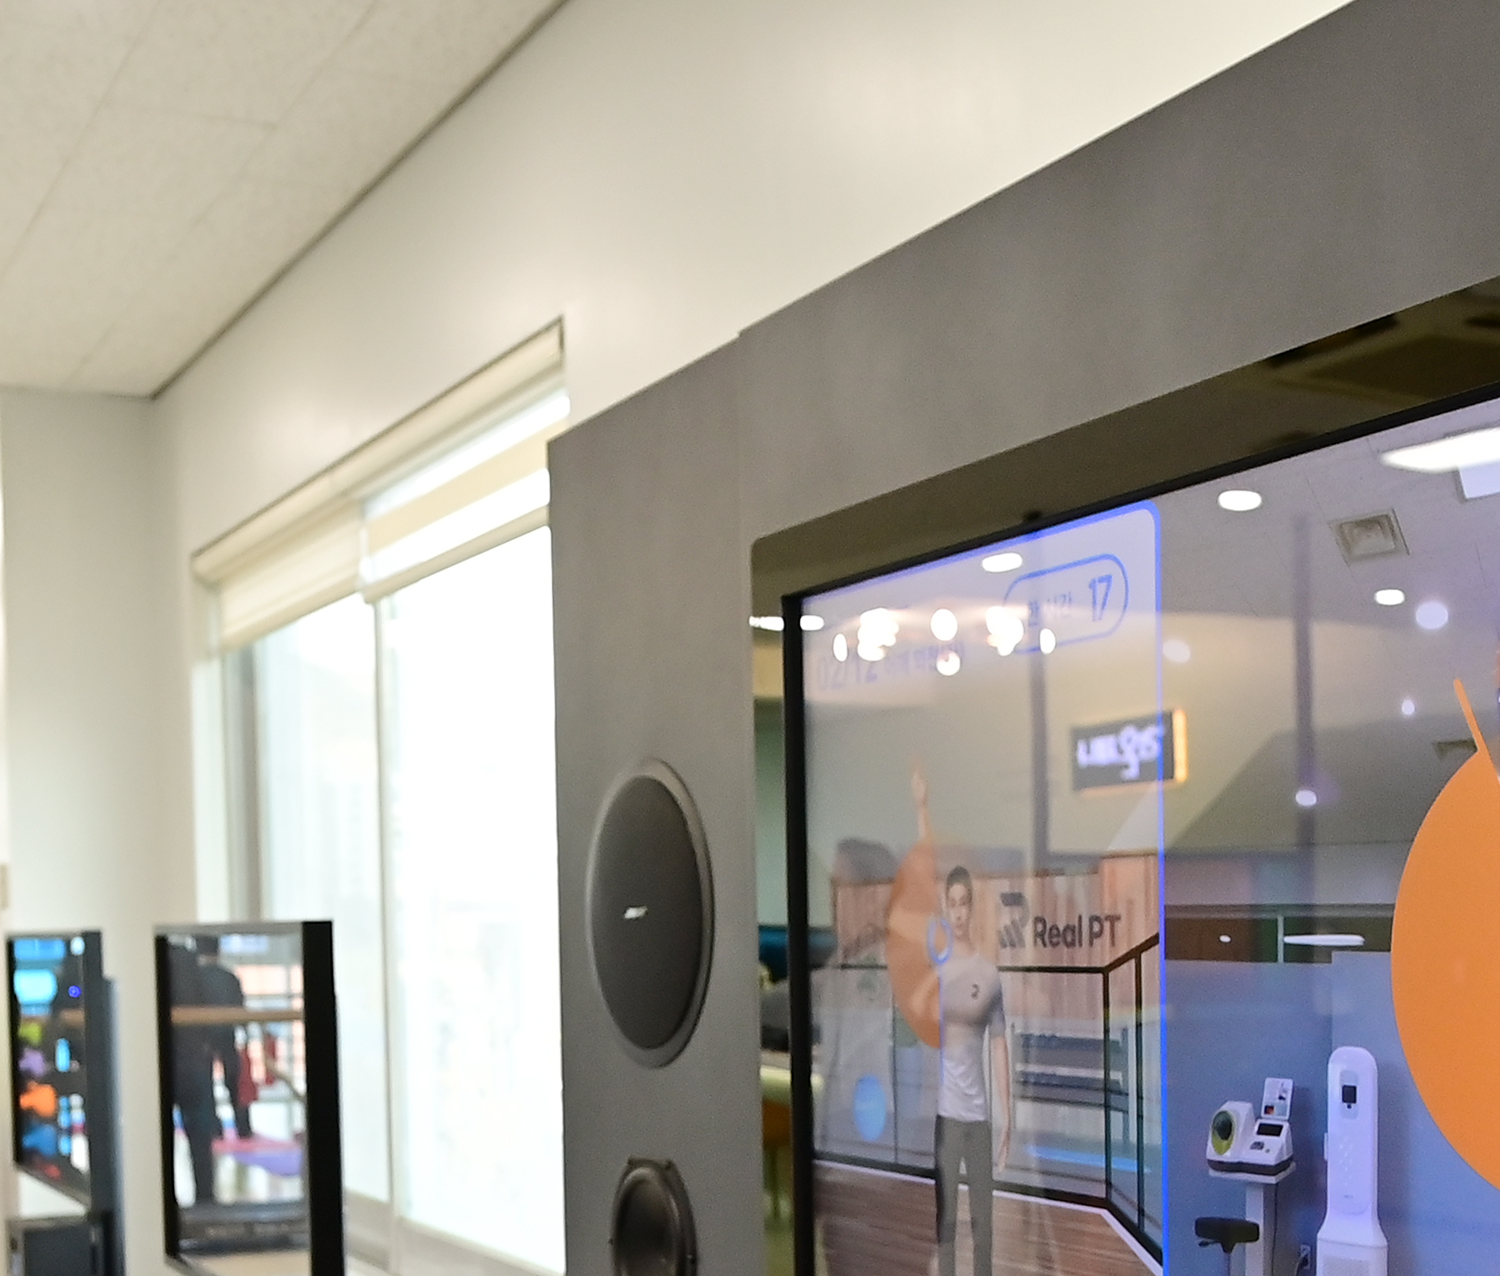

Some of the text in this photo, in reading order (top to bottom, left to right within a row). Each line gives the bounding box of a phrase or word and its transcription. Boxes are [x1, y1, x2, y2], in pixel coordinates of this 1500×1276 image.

[1089, 574, 1113, 622] 17
[1033, 914, 1122, 948] Real PT
